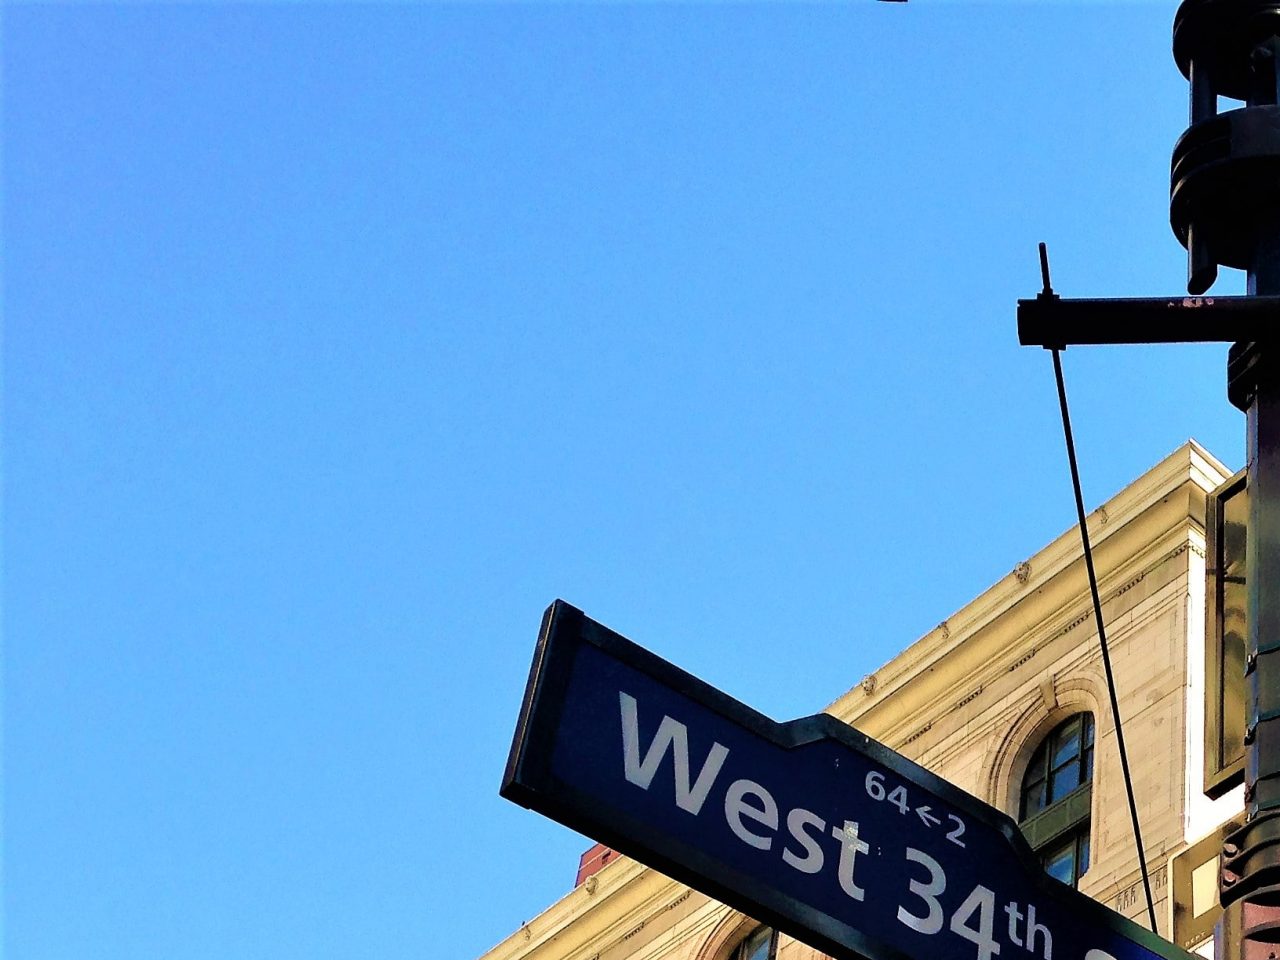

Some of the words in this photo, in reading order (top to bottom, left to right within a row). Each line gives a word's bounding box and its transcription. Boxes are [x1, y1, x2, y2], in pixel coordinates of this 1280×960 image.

[619, 691, 869, 901] West
[865, 770, 910, 815] 64
[946, 814, 966, 848] 2
